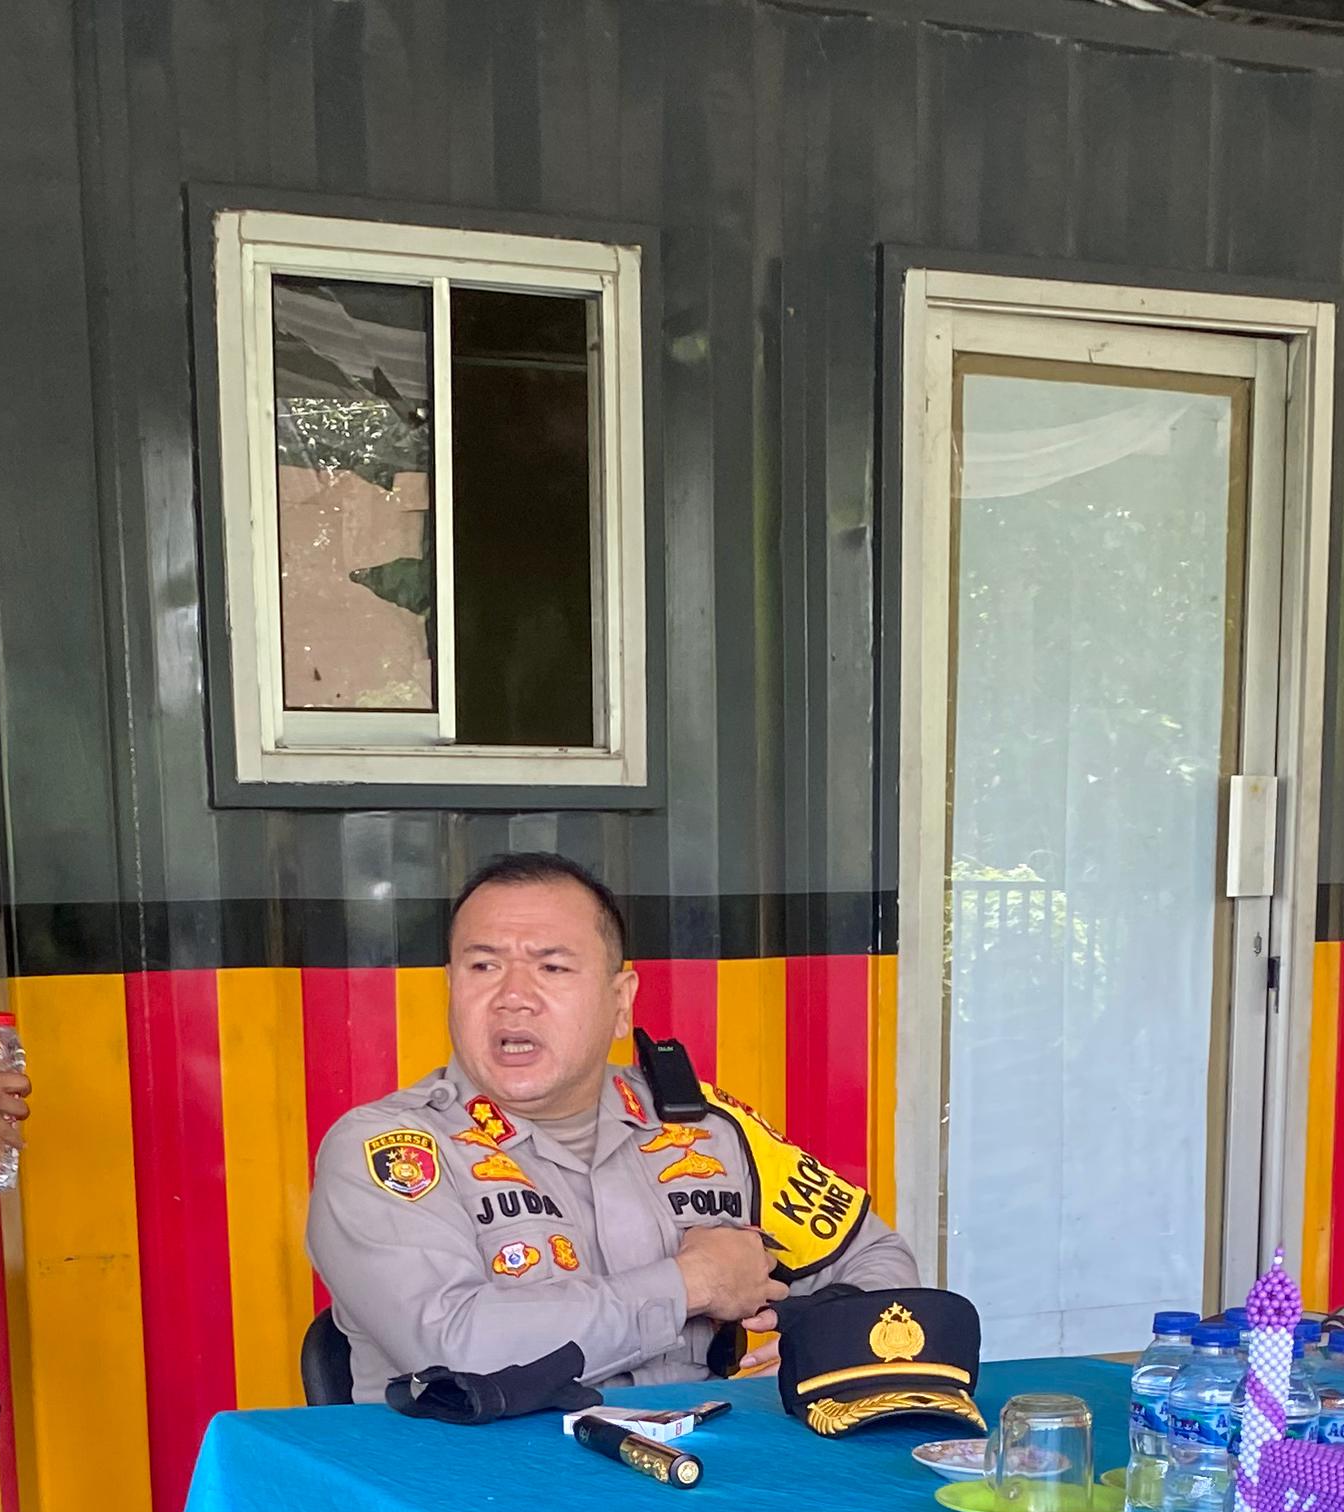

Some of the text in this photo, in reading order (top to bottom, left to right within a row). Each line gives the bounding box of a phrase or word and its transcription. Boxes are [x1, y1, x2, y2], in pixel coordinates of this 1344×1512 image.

[370, 1133, 430, 1150] RESERSE
[476, 1189, 563, 1225] JUDA
[668, 1189, 742, 1218] POLRI
